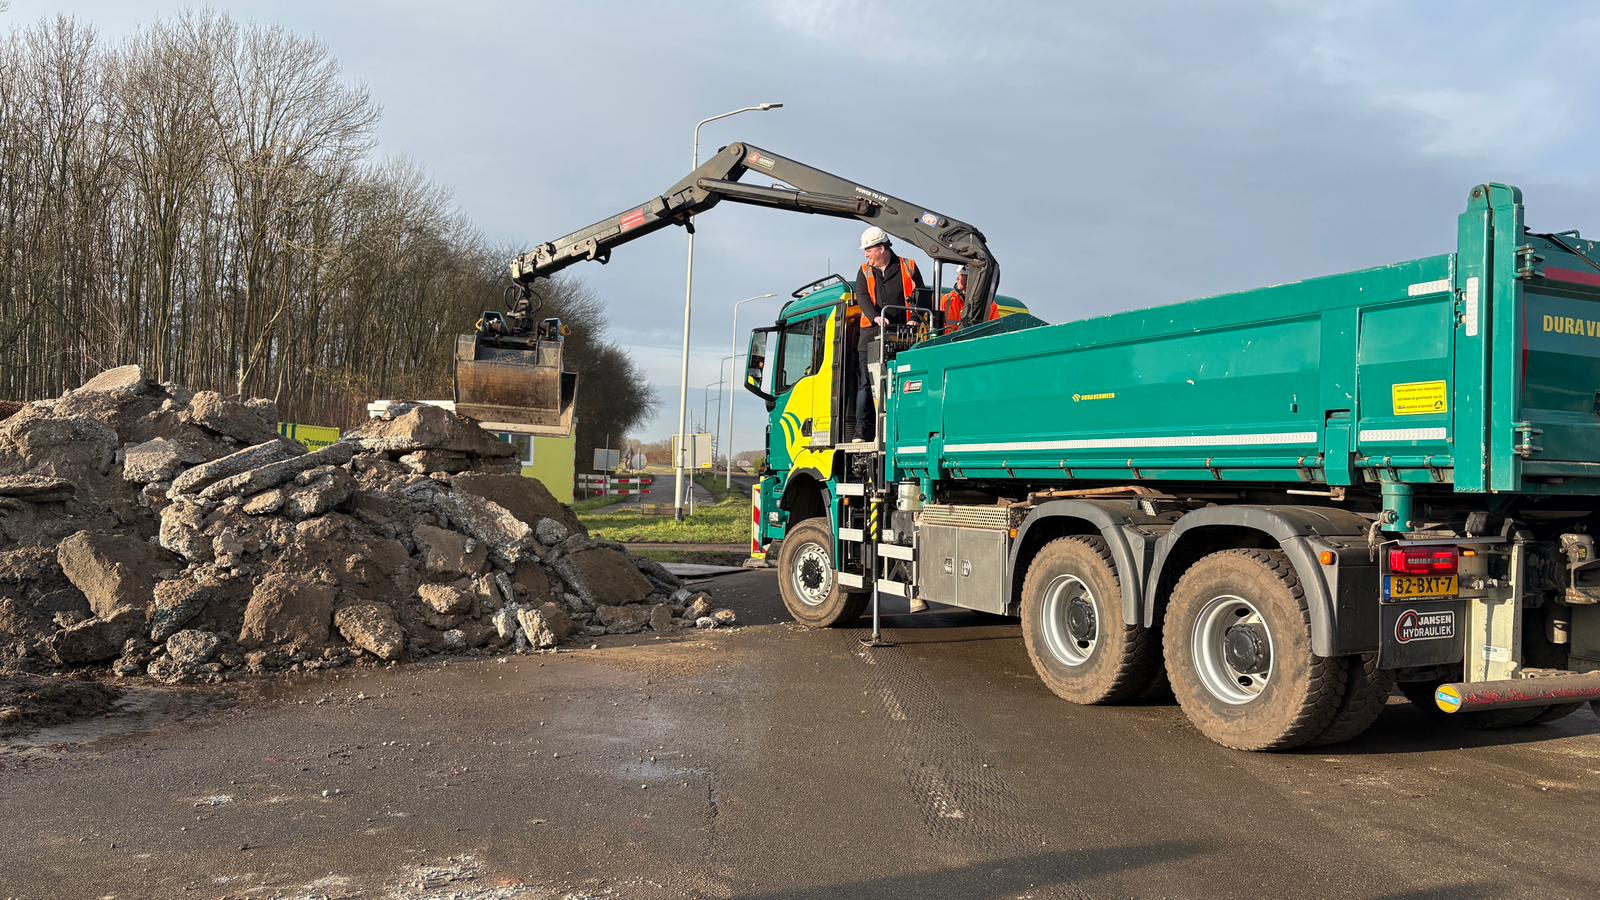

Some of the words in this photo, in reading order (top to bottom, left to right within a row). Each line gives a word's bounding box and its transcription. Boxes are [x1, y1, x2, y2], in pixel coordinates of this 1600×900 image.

[1396, 576, 1453, 594] 82-BXT-7
[1418, 615, 1452, 626] JANSEN
[1403, 626, 1452, 638] HYDRAULIEK
